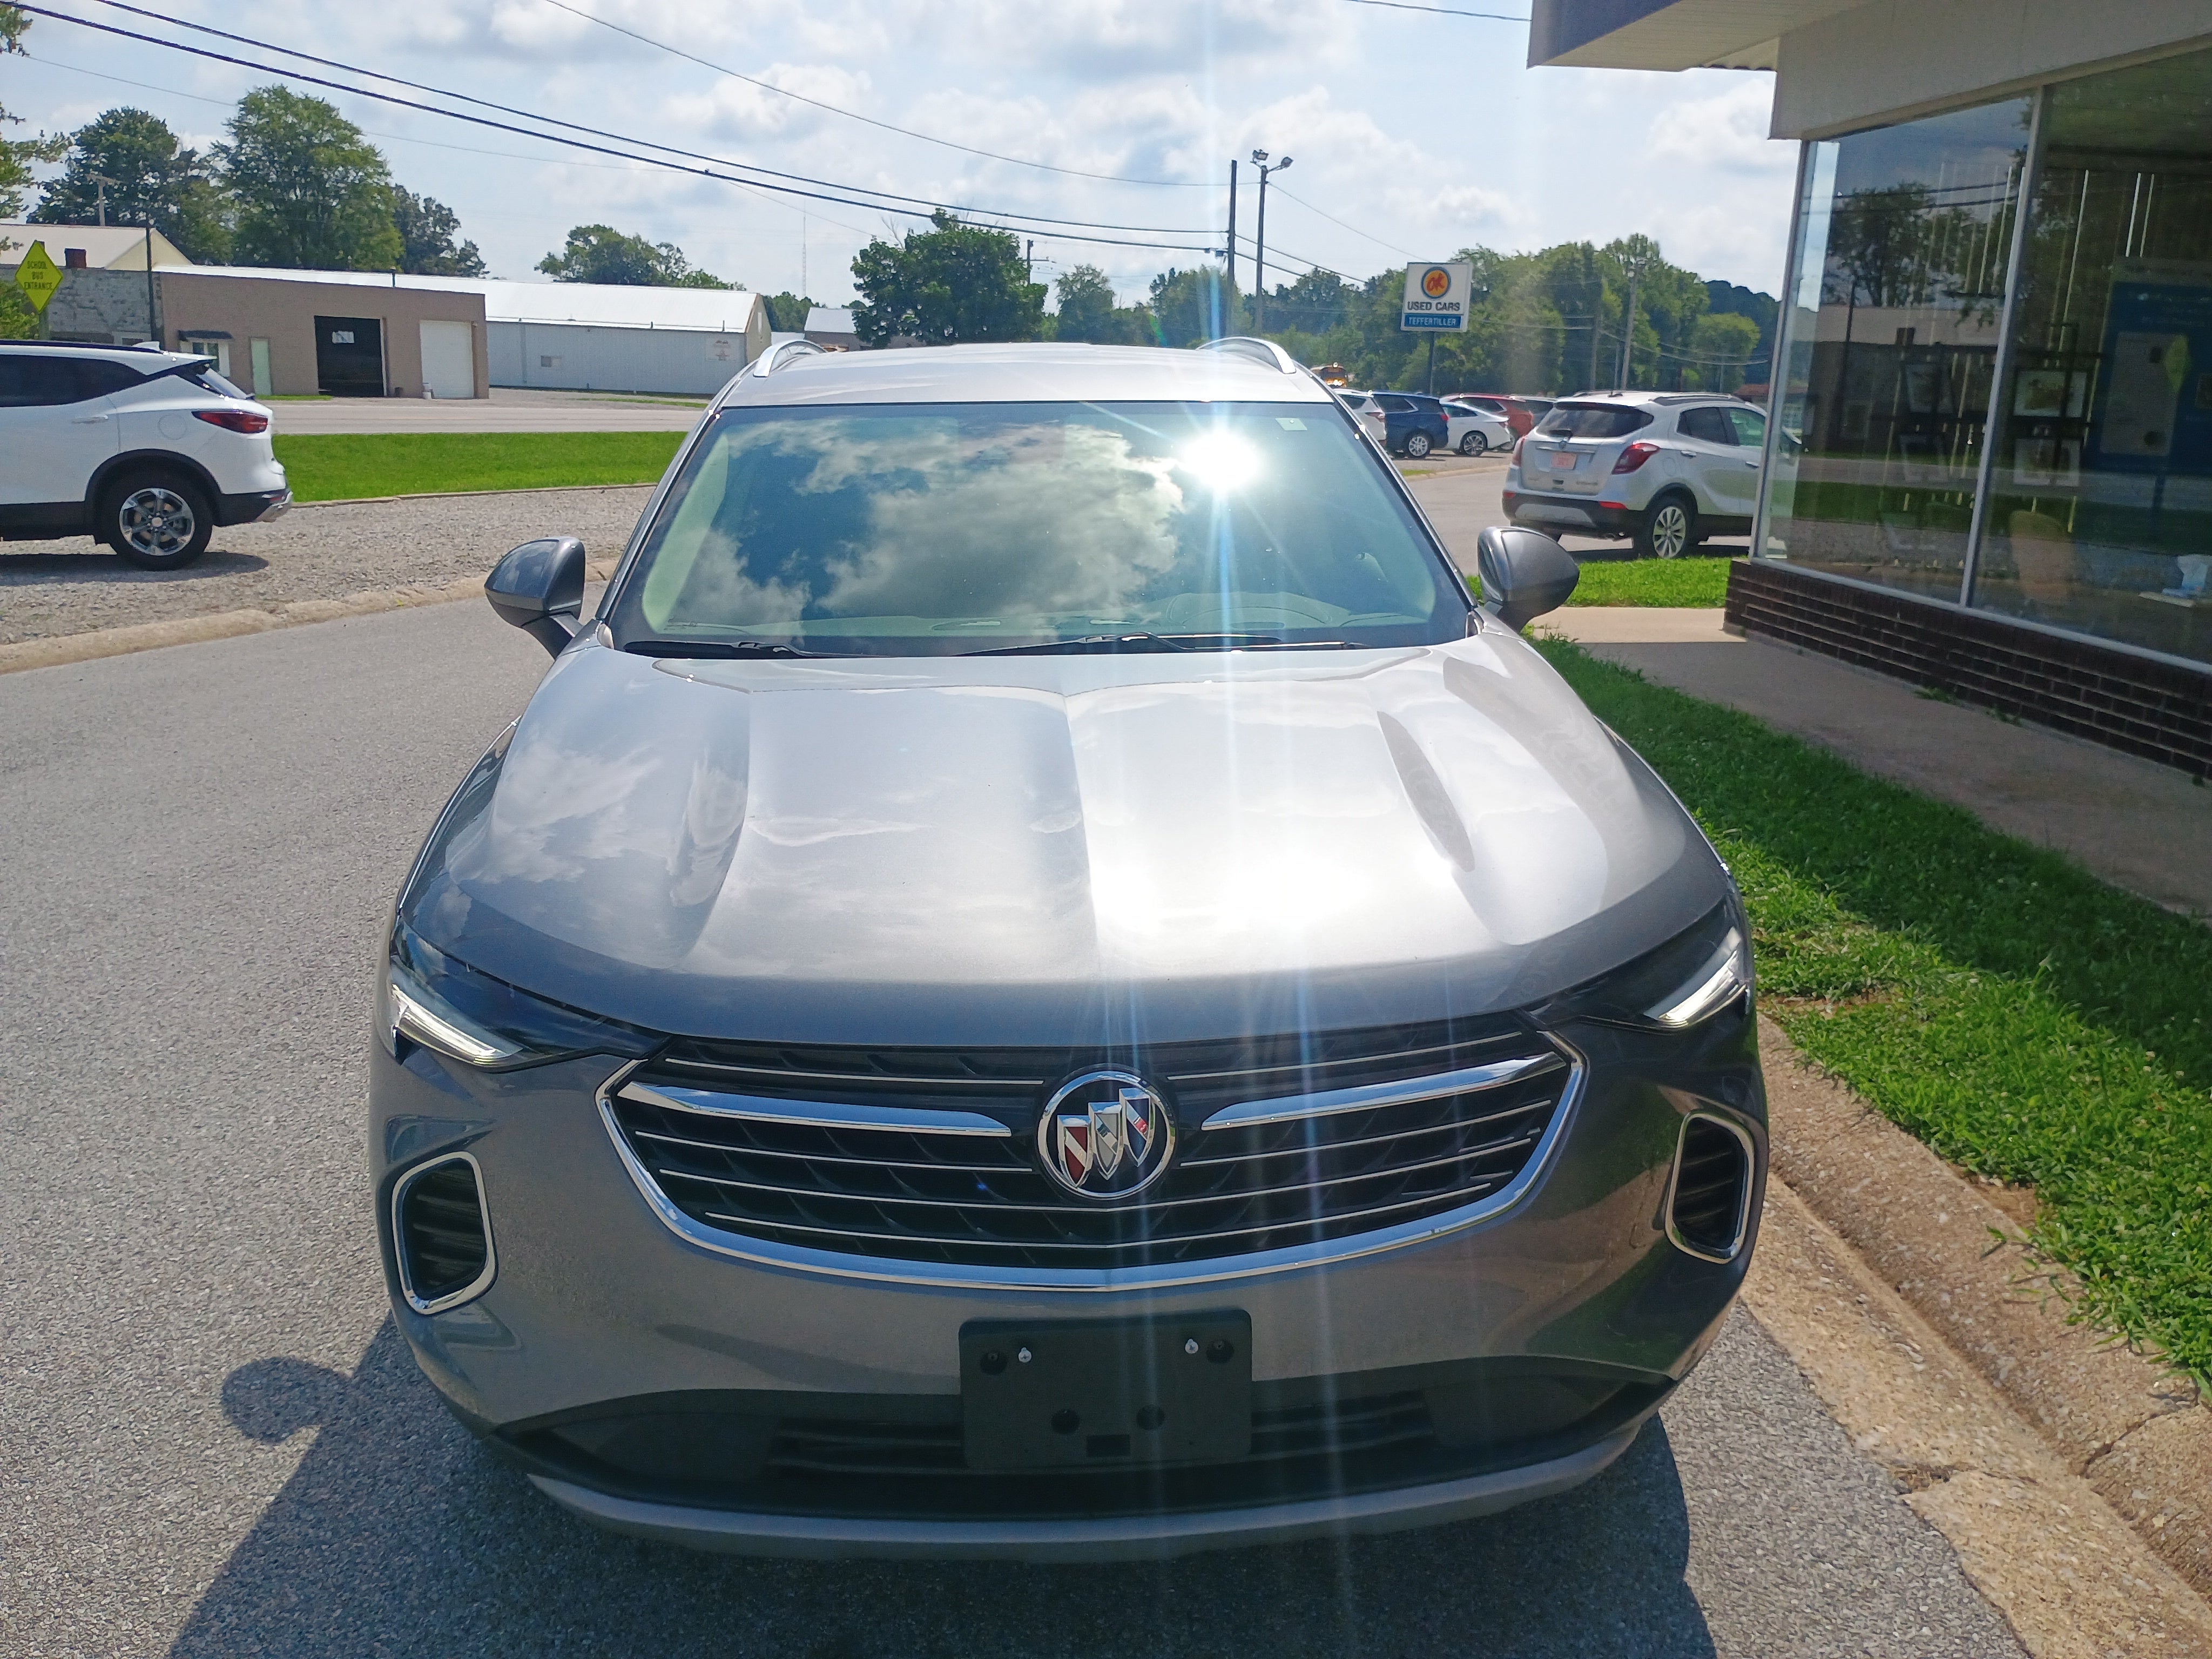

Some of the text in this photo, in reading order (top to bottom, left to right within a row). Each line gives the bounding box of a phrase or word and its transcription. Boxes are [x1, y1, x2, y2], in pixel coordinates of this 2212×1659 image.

[1407, 301, 1460, 311] USED CARS
[1408, 317, 1456, 326] TEFFERTILLER
